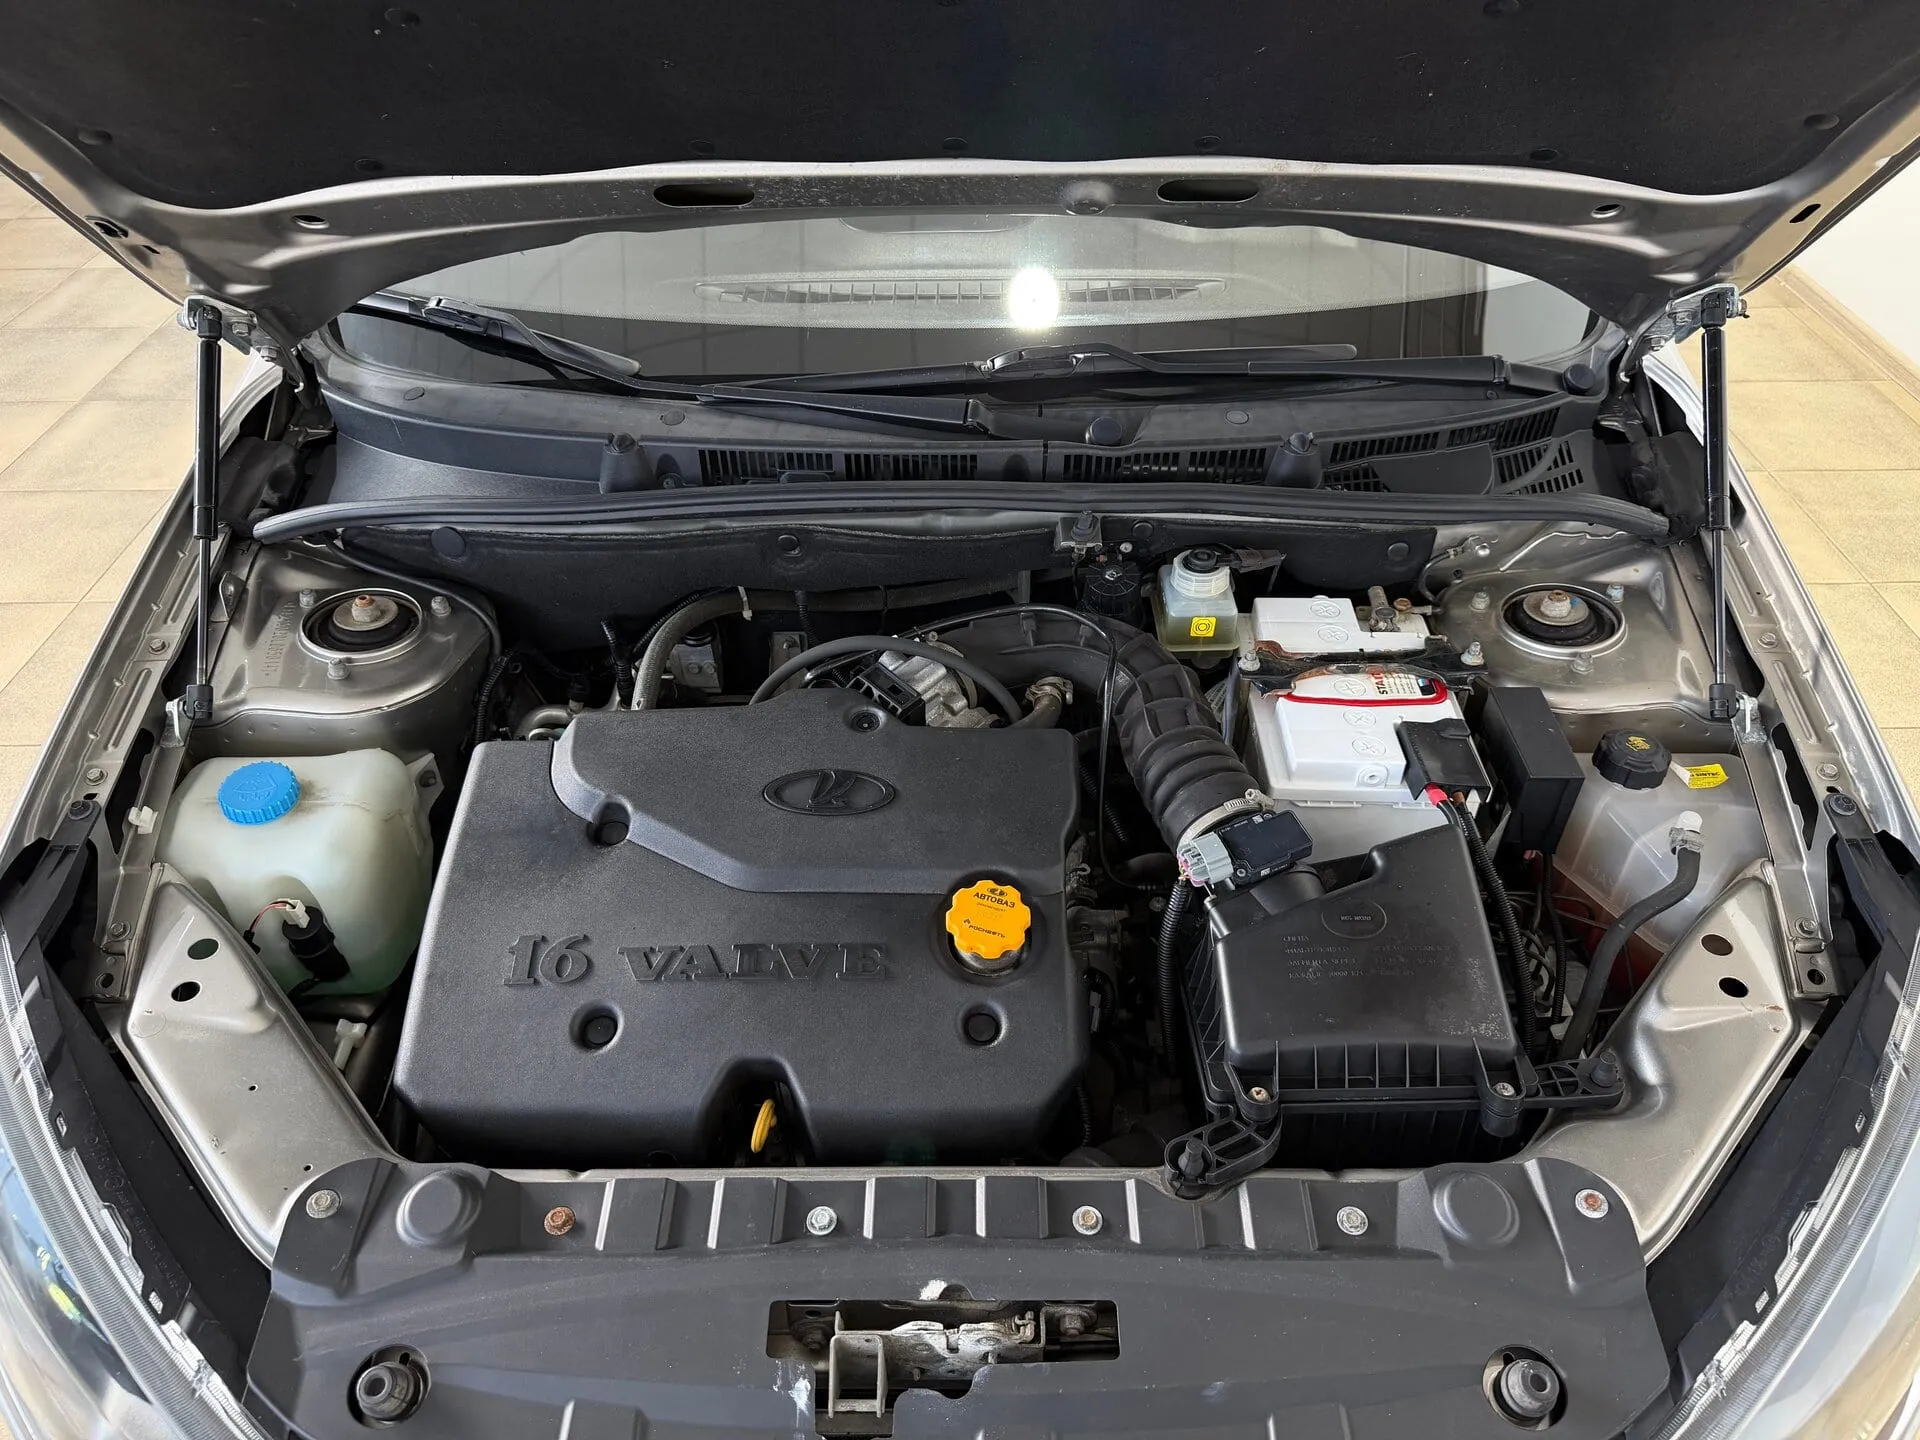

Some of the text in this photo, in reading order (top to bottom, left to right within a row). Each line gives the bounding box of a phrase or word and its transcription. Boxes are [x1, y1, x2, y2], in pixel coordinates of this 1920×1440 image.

[974, 892, 1015, 908] АВТОВАЗ
[503, 934, 889, 986] 16 VALVE
